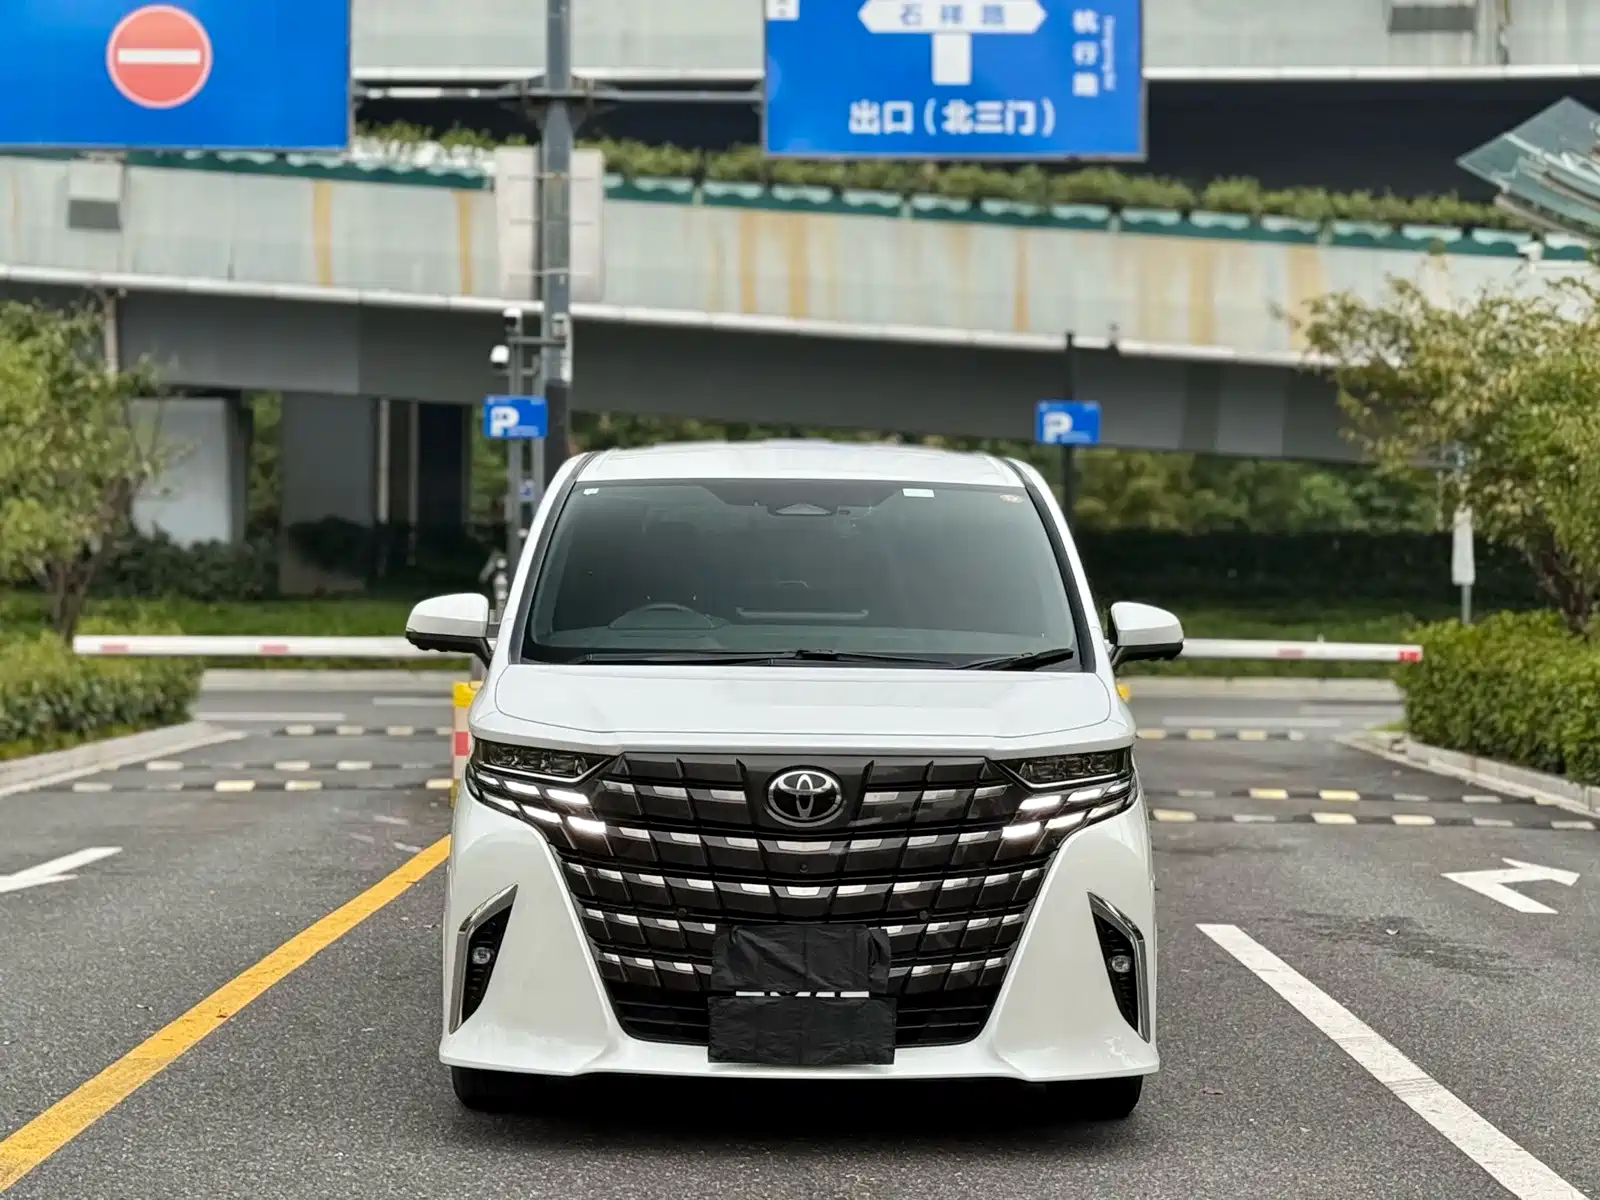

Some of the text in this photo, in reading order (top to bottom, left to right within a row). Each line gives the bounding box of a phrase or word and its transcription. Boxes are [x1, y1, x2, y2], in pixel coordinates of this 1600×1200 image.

[849, 98, 1056, 137] 出口（北三门）
[490, 406, 519, 437] P
[1043, 411, 1073, 443] P
